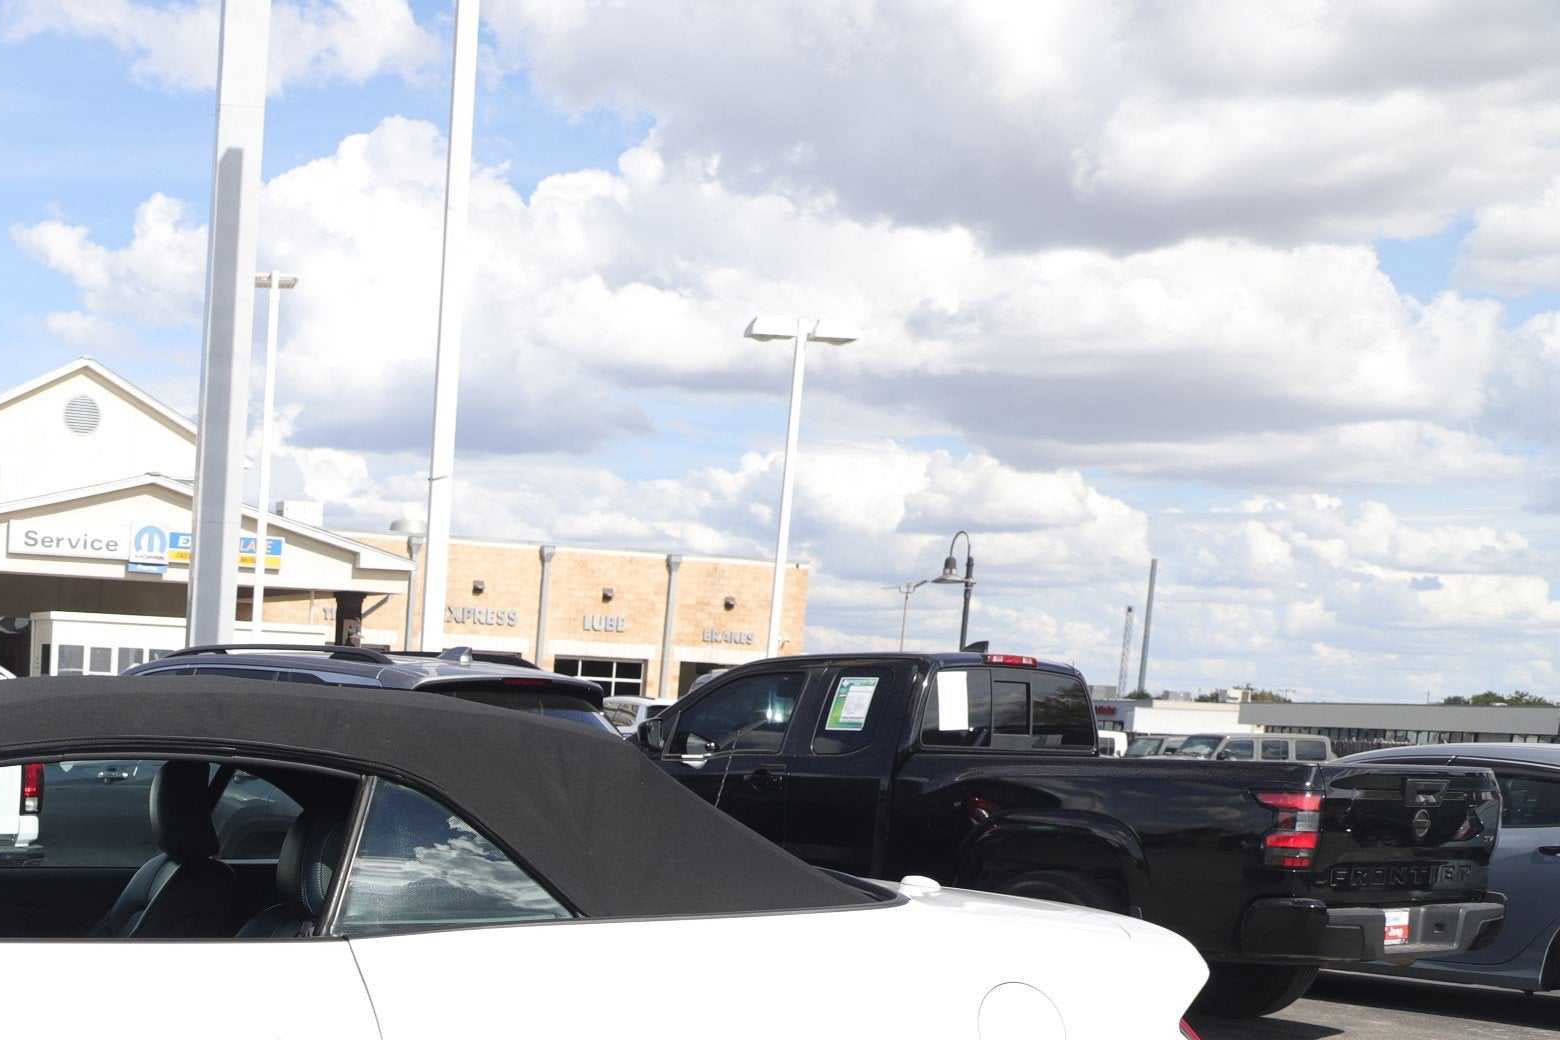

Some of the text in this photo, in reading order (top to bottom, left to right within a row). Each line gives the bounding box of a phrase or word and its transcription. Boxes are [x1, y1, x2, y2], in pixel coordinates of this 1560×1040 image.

[24, 530, 119, 552] Service
[241, 538, 273, 553] LAE
[444, 607, 519, 627] XPRESS
[583, 615, 625, 633] LUBE
[702, 629, 755, 645] BRAKES
[1330, 864, 1473, 888] FRONTIER
